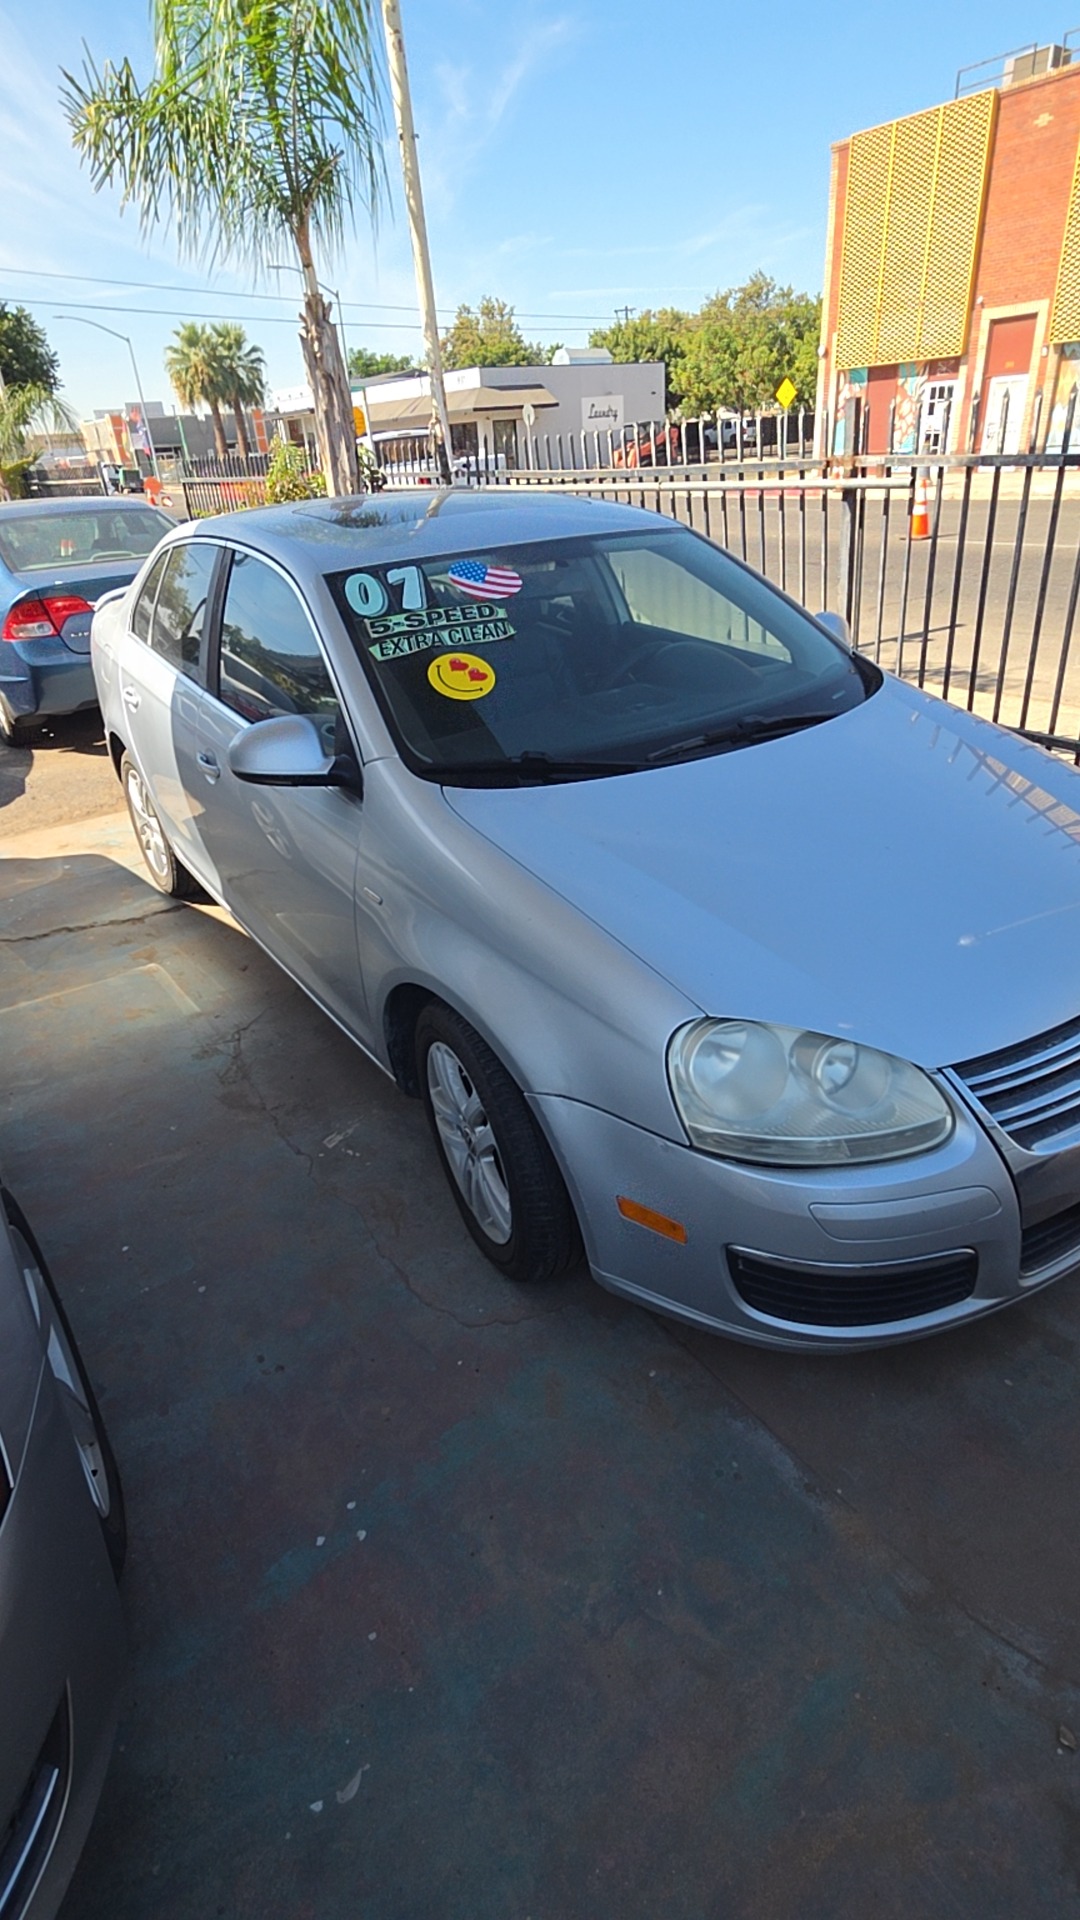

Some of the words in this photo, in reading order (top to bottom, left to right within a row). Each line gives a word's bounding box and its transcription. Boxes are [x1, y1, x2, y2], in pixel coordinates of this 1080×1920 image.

[345, 566, 427, 617] 07
[369, 604, 497, 635] 5-SPEED
[379, 633, 445, 657] EXTRA
[449, 621, 508, 645] CLEAN
